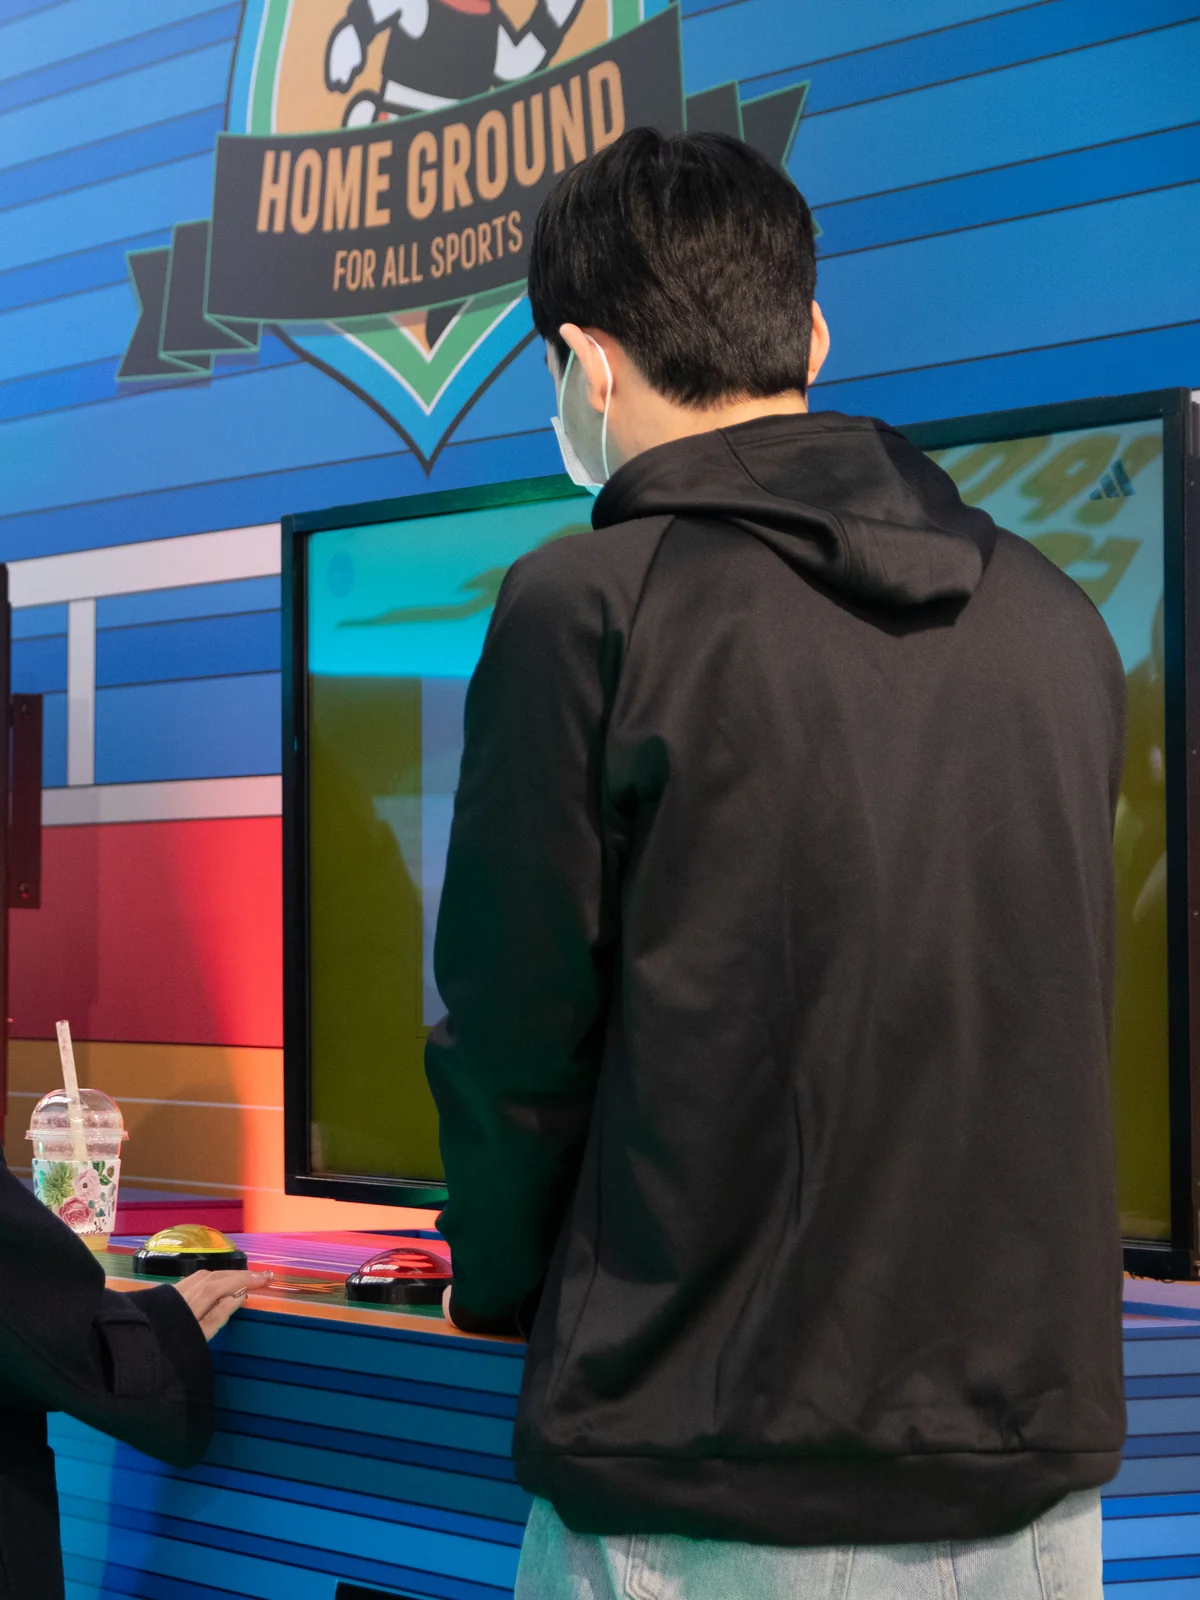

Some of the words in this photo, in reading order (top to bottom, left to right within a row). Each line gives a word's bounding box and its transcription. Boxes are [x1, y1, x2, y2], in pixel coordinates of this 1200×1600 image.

[256, 140, 393, 235] HOME
[406, 60, 626, 220] GROUND
[332, 248, 377, 292] FOR
[381, 241, 424, 289] ALL
[430, 209, 524, 279] SPORTS
